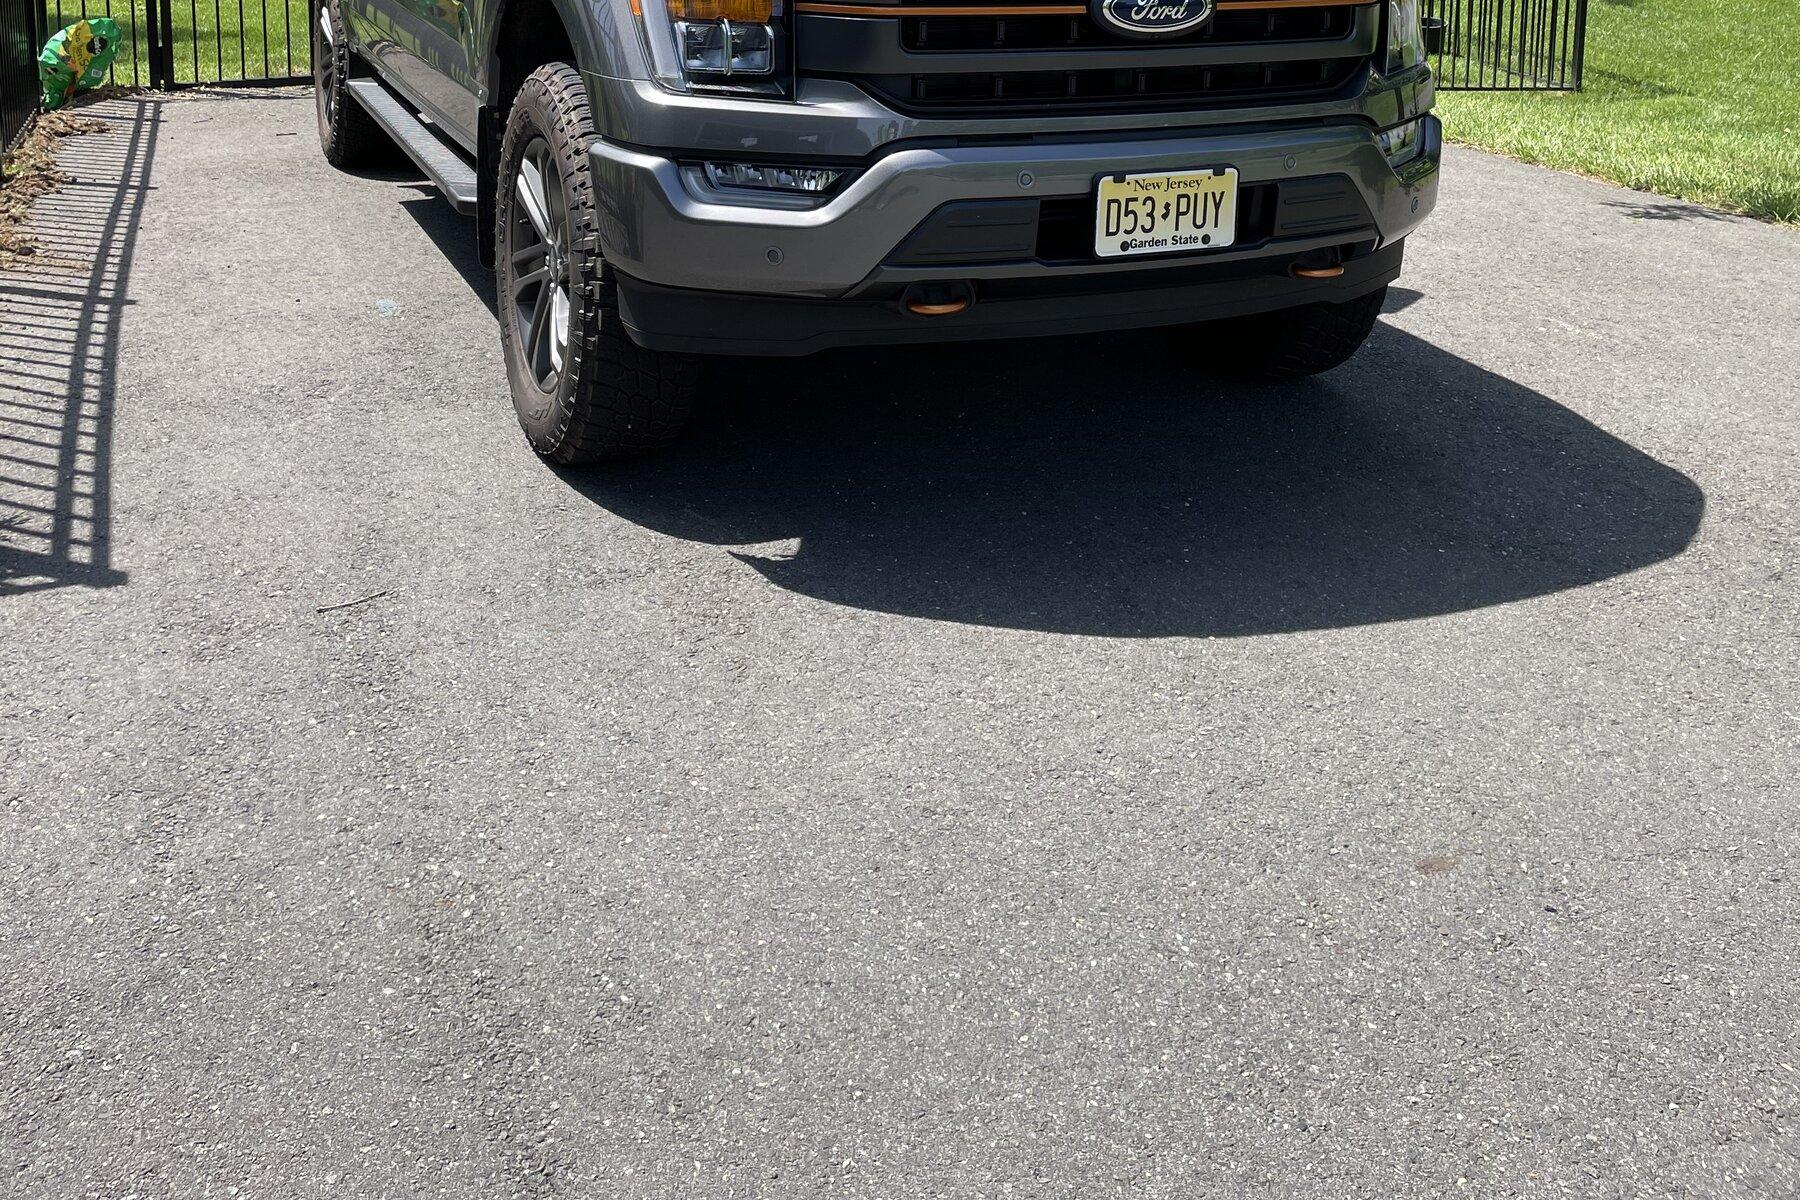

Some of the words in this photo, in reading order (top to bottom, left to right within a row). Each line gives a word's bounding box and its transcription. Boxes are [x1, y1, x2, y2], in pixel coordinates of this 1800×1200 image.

[1133, 179, 1162, 192] New
[1164, 177, 1203, 192] Jersey
[1129, 237, 1168, 249] Garden
[1171, 233, 1199, 246] State
